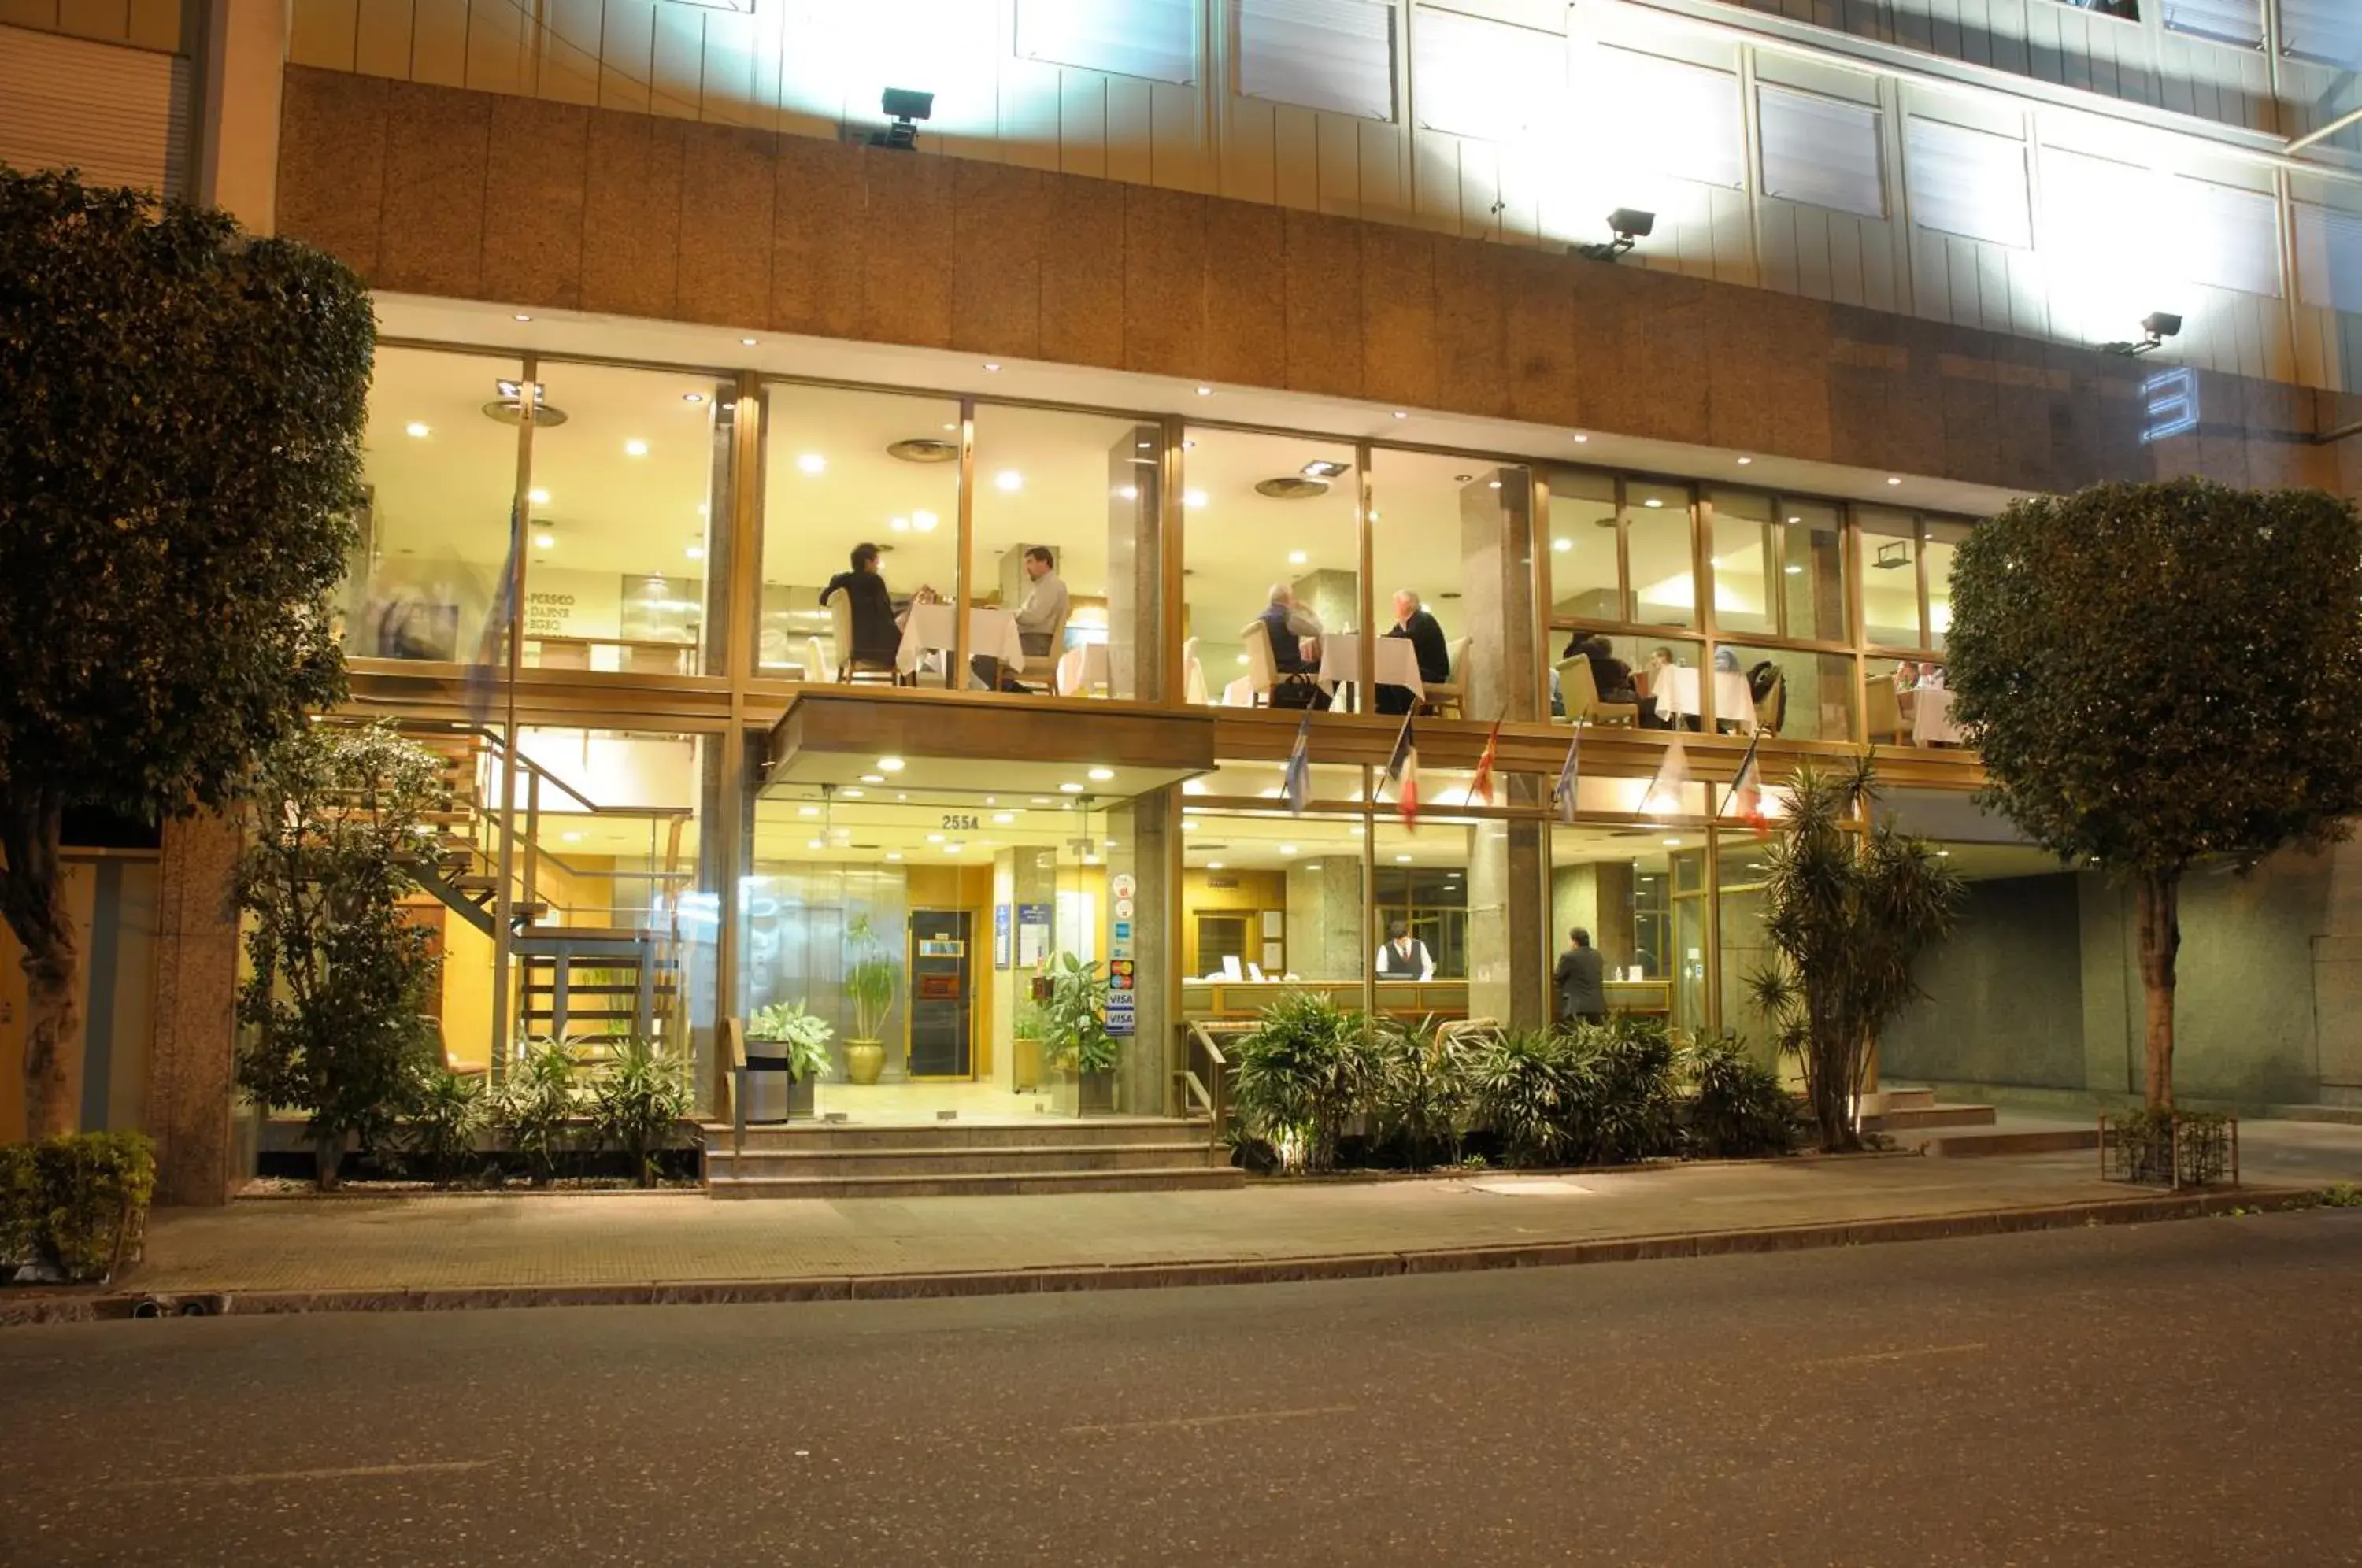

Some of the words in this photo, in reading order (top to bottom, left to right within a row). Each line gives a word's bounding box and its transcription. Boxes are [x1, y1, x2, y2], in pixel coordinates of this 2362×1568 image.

[942, 815, 979, 830] 2554
[1109, 994, 1133, 1004] VISA
[1109, 1013, 1133, 1023] VISA
